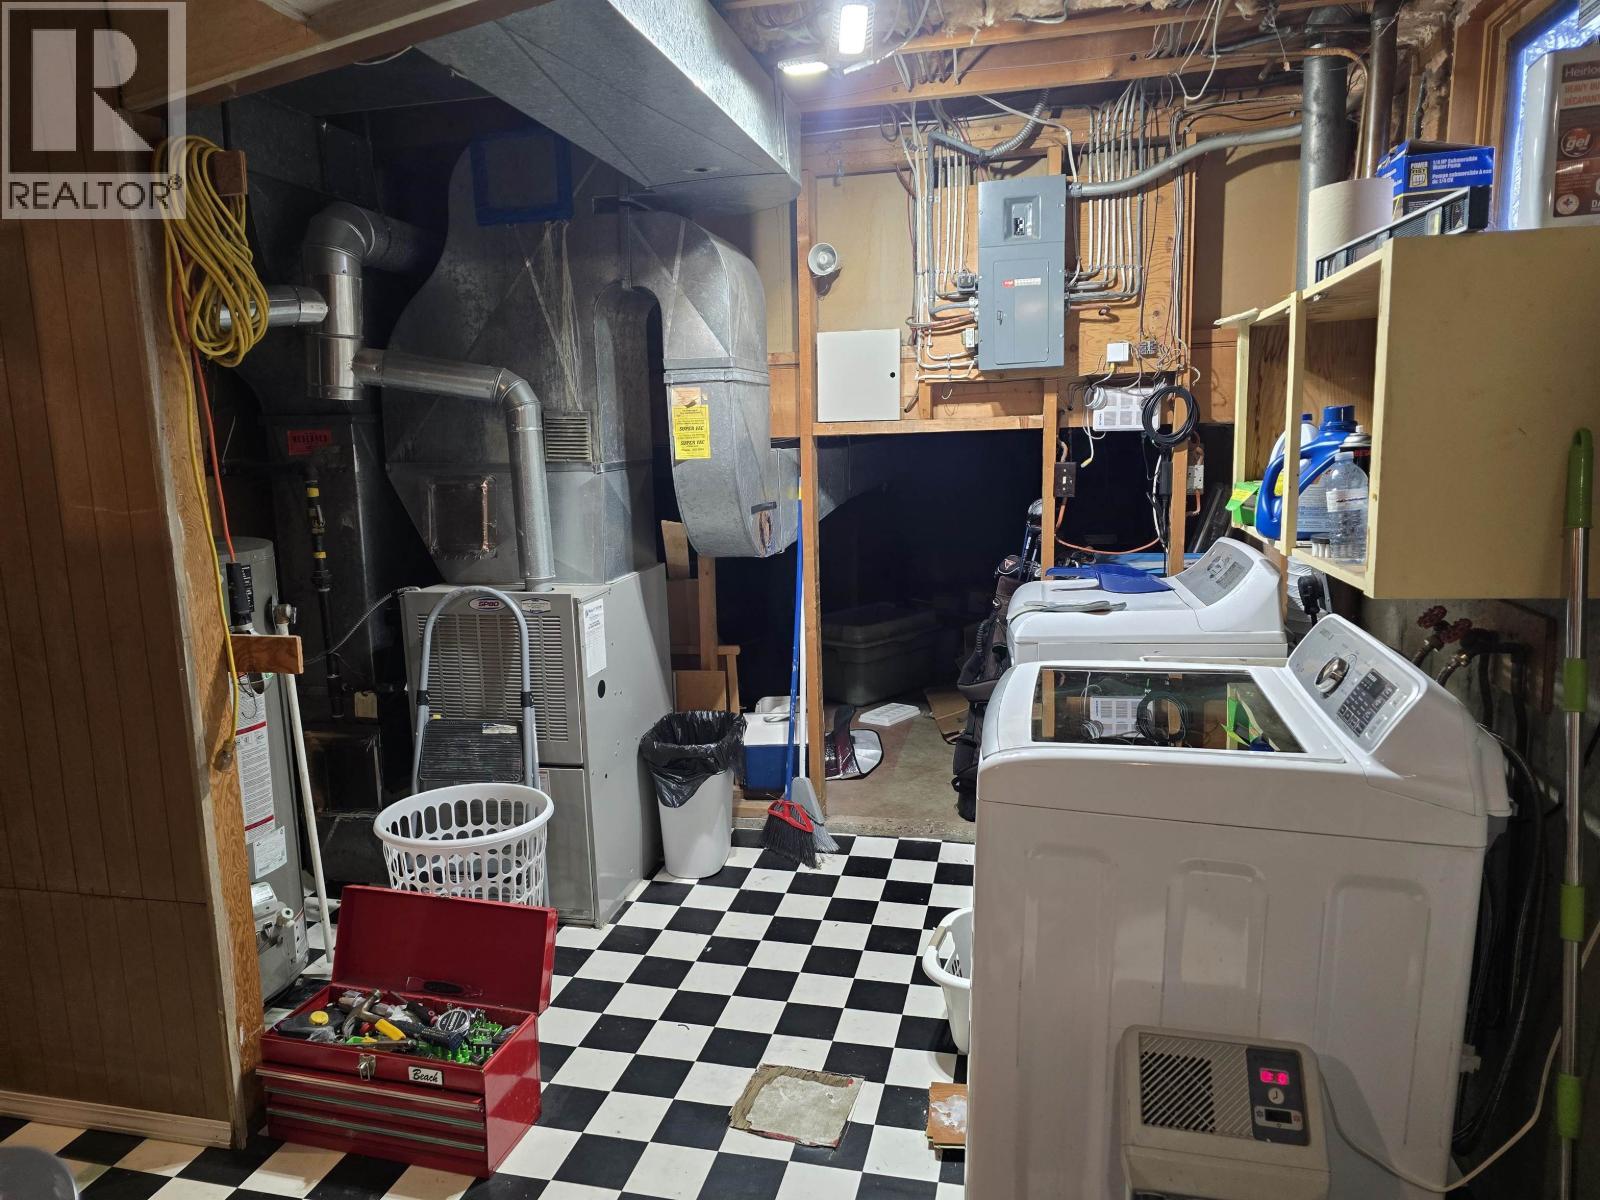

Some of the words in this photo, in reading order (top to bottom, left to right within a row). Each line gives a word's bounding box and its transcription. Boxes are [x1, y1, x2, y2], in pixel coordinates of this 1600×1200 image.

[1564, 63, 1600, 79] Heirlo
[1565, 133, 1591, 151] gel
[412, 1069, 438, 1082] Beach
